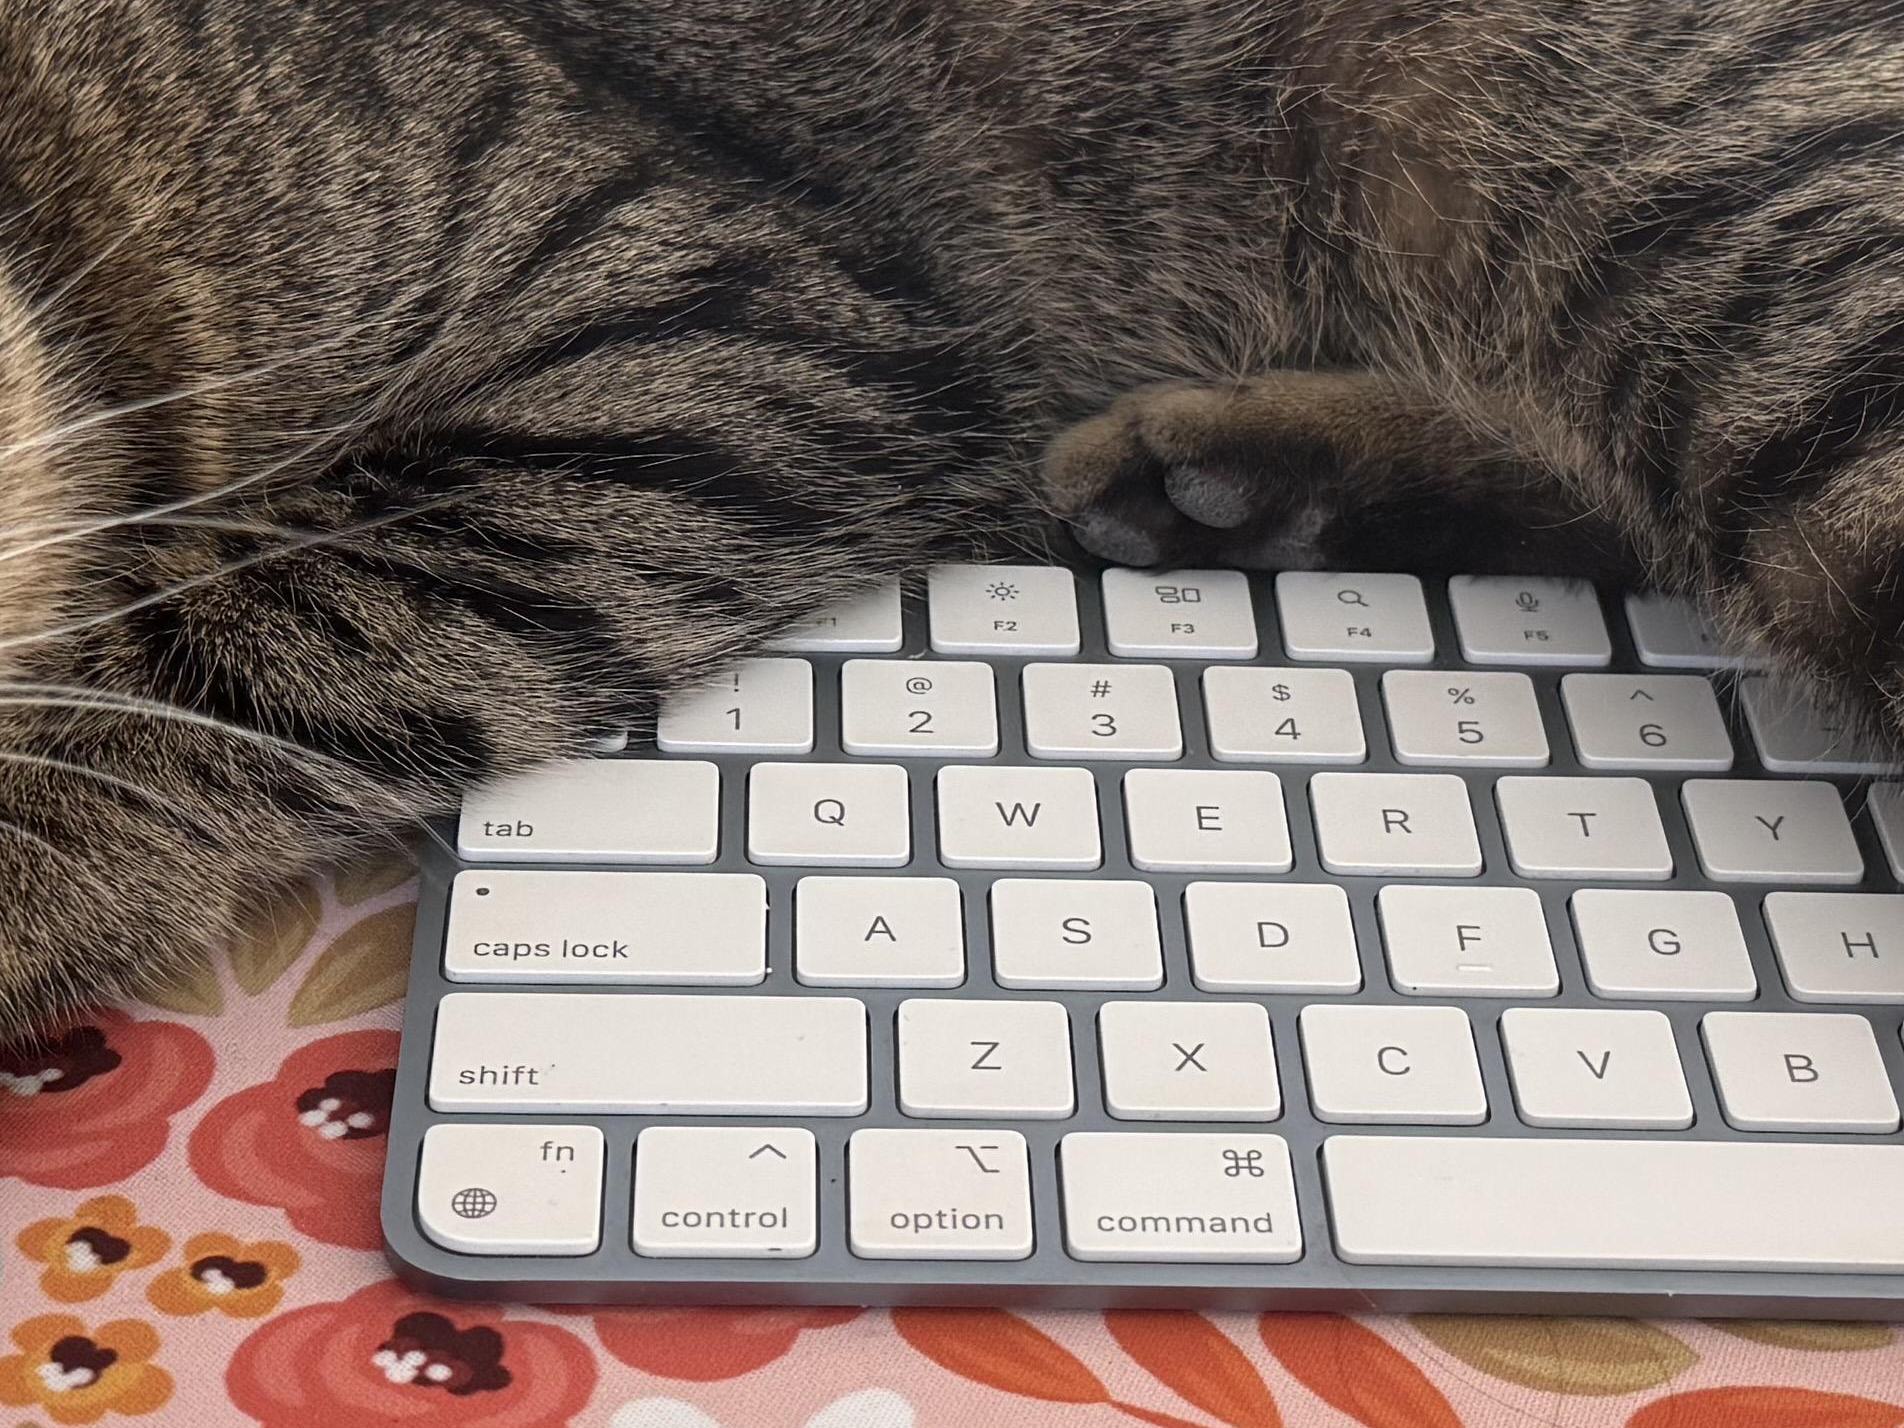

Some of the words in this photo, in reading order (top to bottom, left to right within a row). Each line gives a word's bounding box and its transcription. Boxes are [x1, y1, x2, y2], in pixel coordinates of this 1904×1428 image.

[994, 621, 1016, 631] F2
[1171, 624, 1194, 633] F3
[1347, 628, 1371, 637] F4
[1524, 631, 1549, 640] F5
[906, 678, 932, 694] @
[1091, 681, 1112, 697] #
[1272, 684, 1290, 701] $
[1448, 688, 1475, 704] %
[727, 708, 740, 730] 1
[909, 711, 933, 733] 2
[1092, 714, 1116, 736] 3
[1275, 718, 1301, 740] 4
[1458, 721, 1483, 743] 5
[1640, 724, 1667, 746] 6
[814, 799, 844, 826] Q
[996, 802, 1040, 827] W
[1196, 806, 1222, 830] E
[1382, 809, 1411, 833] R
[484, 821, 533, 836] tab
[1568, 813, 1596, 837] T
[1756, 816, 1784, 840] Y
[865, 916, 896, 941] A
[1063, 918, 1091, 944] S
[1258, 922, 1289, 947] D
[1457, 925, 1481, 951] F
[474, 943, 549, 960] caps
[563, 940, 628, 958] lock
[1648, 929, 1680, 955] G
[1844, 932, 1879, 958] H
[971, 1042, 1001, 1069] Z
[1173, 1043, 1206, 1071] X
[1378, 1047, 1410, 1075] C
[1577, 1051, 1610, 1079] V
[459, 1066, 538, 1085] shift
[1784, 1054, 1818, 1082] B
[541, 1141, 574, 1161] fn
[662, 1207, 786, 1228] control
[891, 1208, 1003, 1233] option
[1098, 1213, 1272, 1233] command
